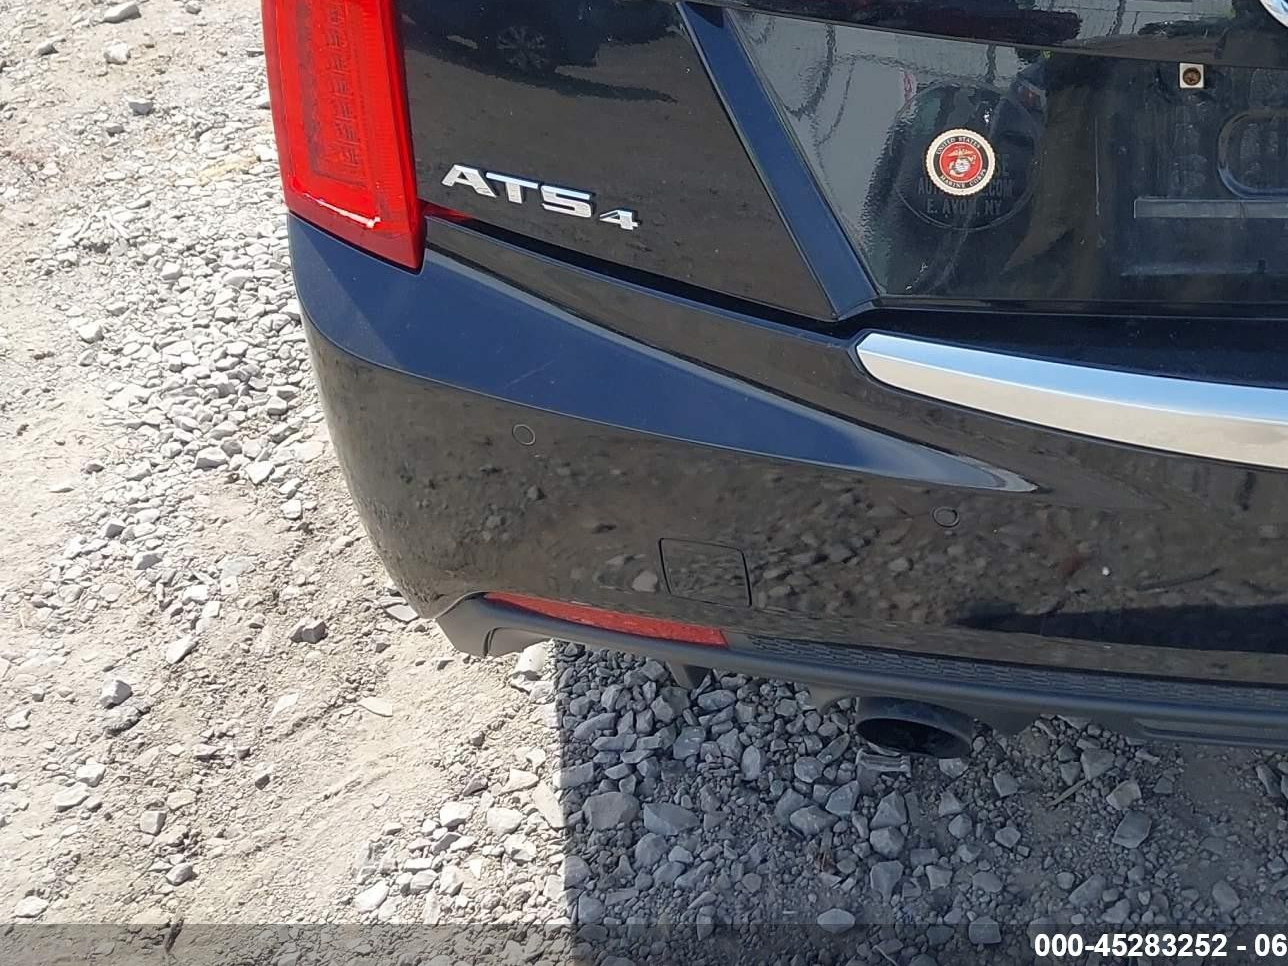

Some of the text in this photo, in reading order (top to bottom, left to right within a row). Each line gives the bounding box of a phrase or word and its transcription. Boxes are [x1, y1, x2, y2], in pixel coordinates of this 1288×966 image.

[936, 136, 981, 154] UNITED STATES
[940, 174, 966, 189] MARINE
[969, 169, 987, 187] CORPS
